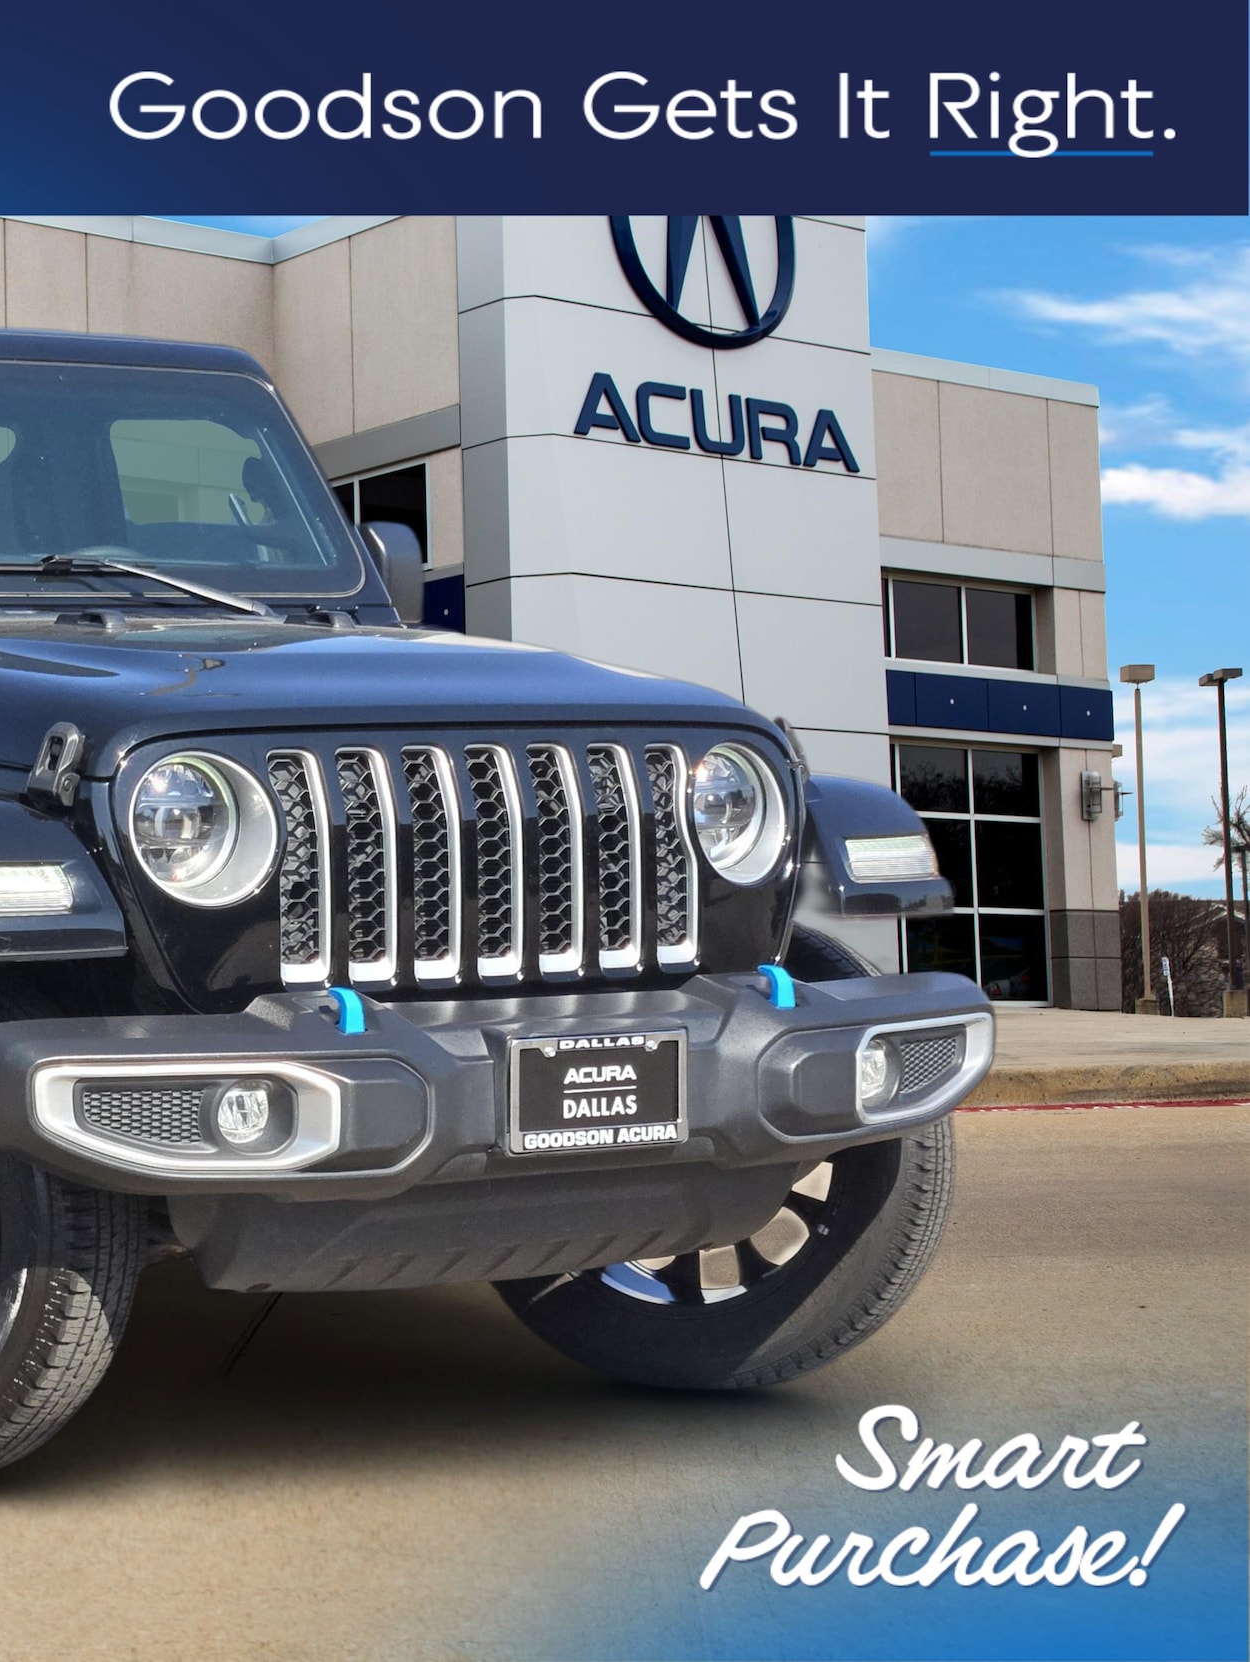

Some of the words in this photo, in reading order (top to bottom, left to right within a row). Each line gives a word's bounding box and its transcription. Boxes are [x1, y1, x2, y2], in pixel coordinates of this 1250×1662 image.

[574, 372, 860, 473] ACURA
[559, 1036, 645, 1050] DALLAS
[563, 1064, 638, 1085] ACURA
[562, 1094, 638, 1120] DALLAS
[524, 1128, 614, 1150] GOODSON
[617, 1124, 678, 1145] ACURA
